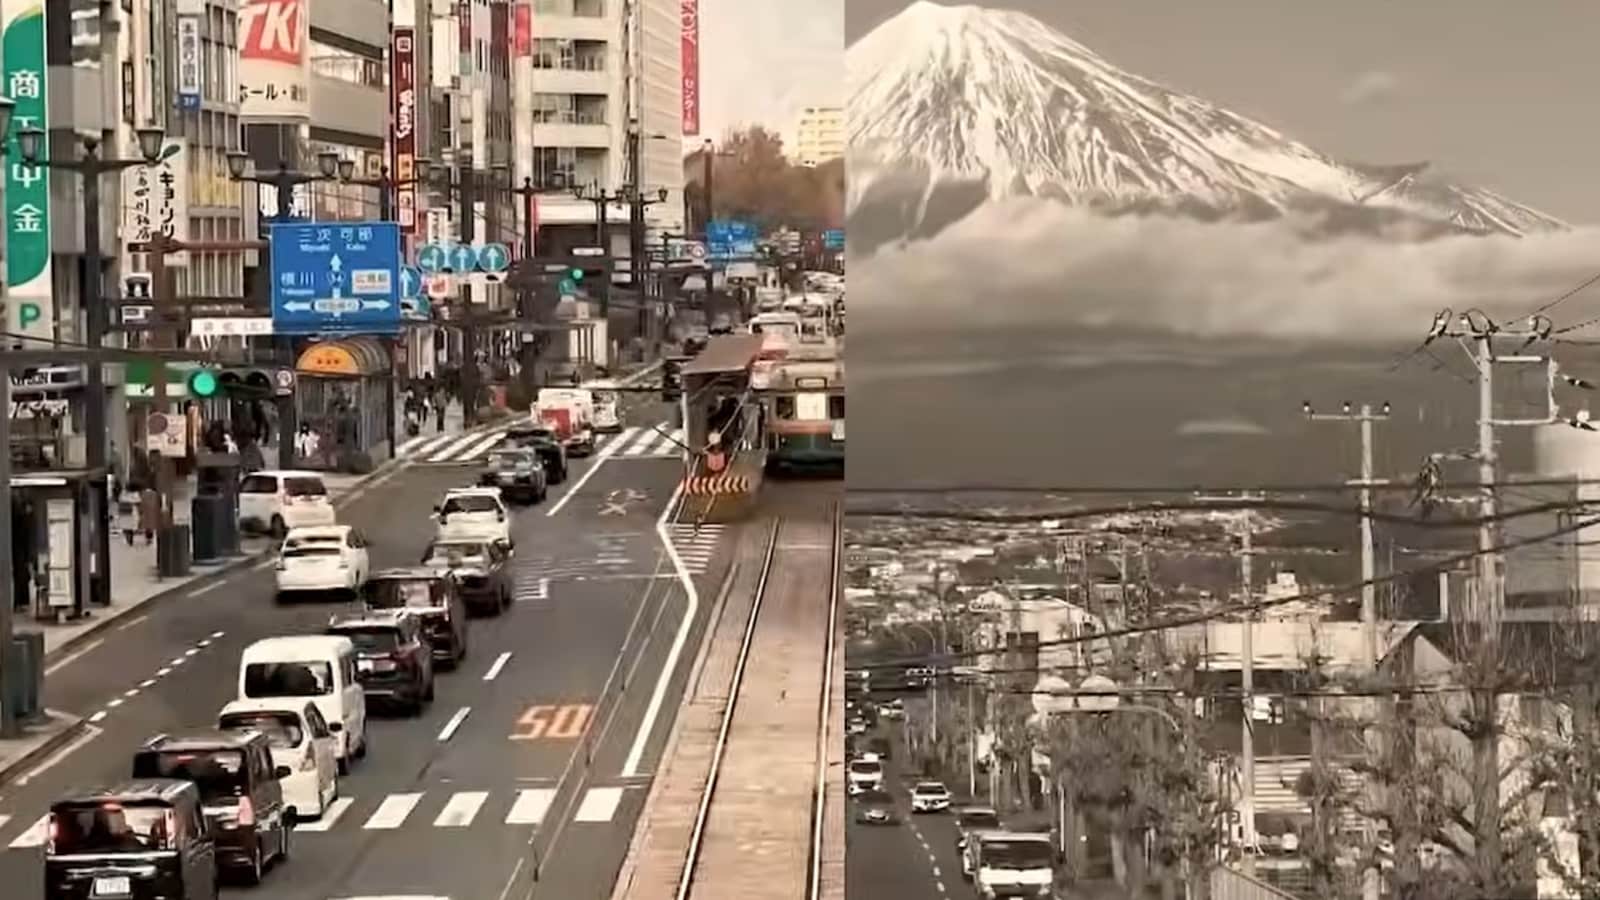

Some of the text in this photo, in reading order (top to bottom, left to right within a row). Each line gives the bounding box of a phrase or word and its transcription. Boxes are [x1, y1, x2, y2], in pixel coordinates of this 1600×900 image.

[299, 228, 331, 242] 三次
[20, 303, 41, 329] P
[507, 704, 592, 740] 50
